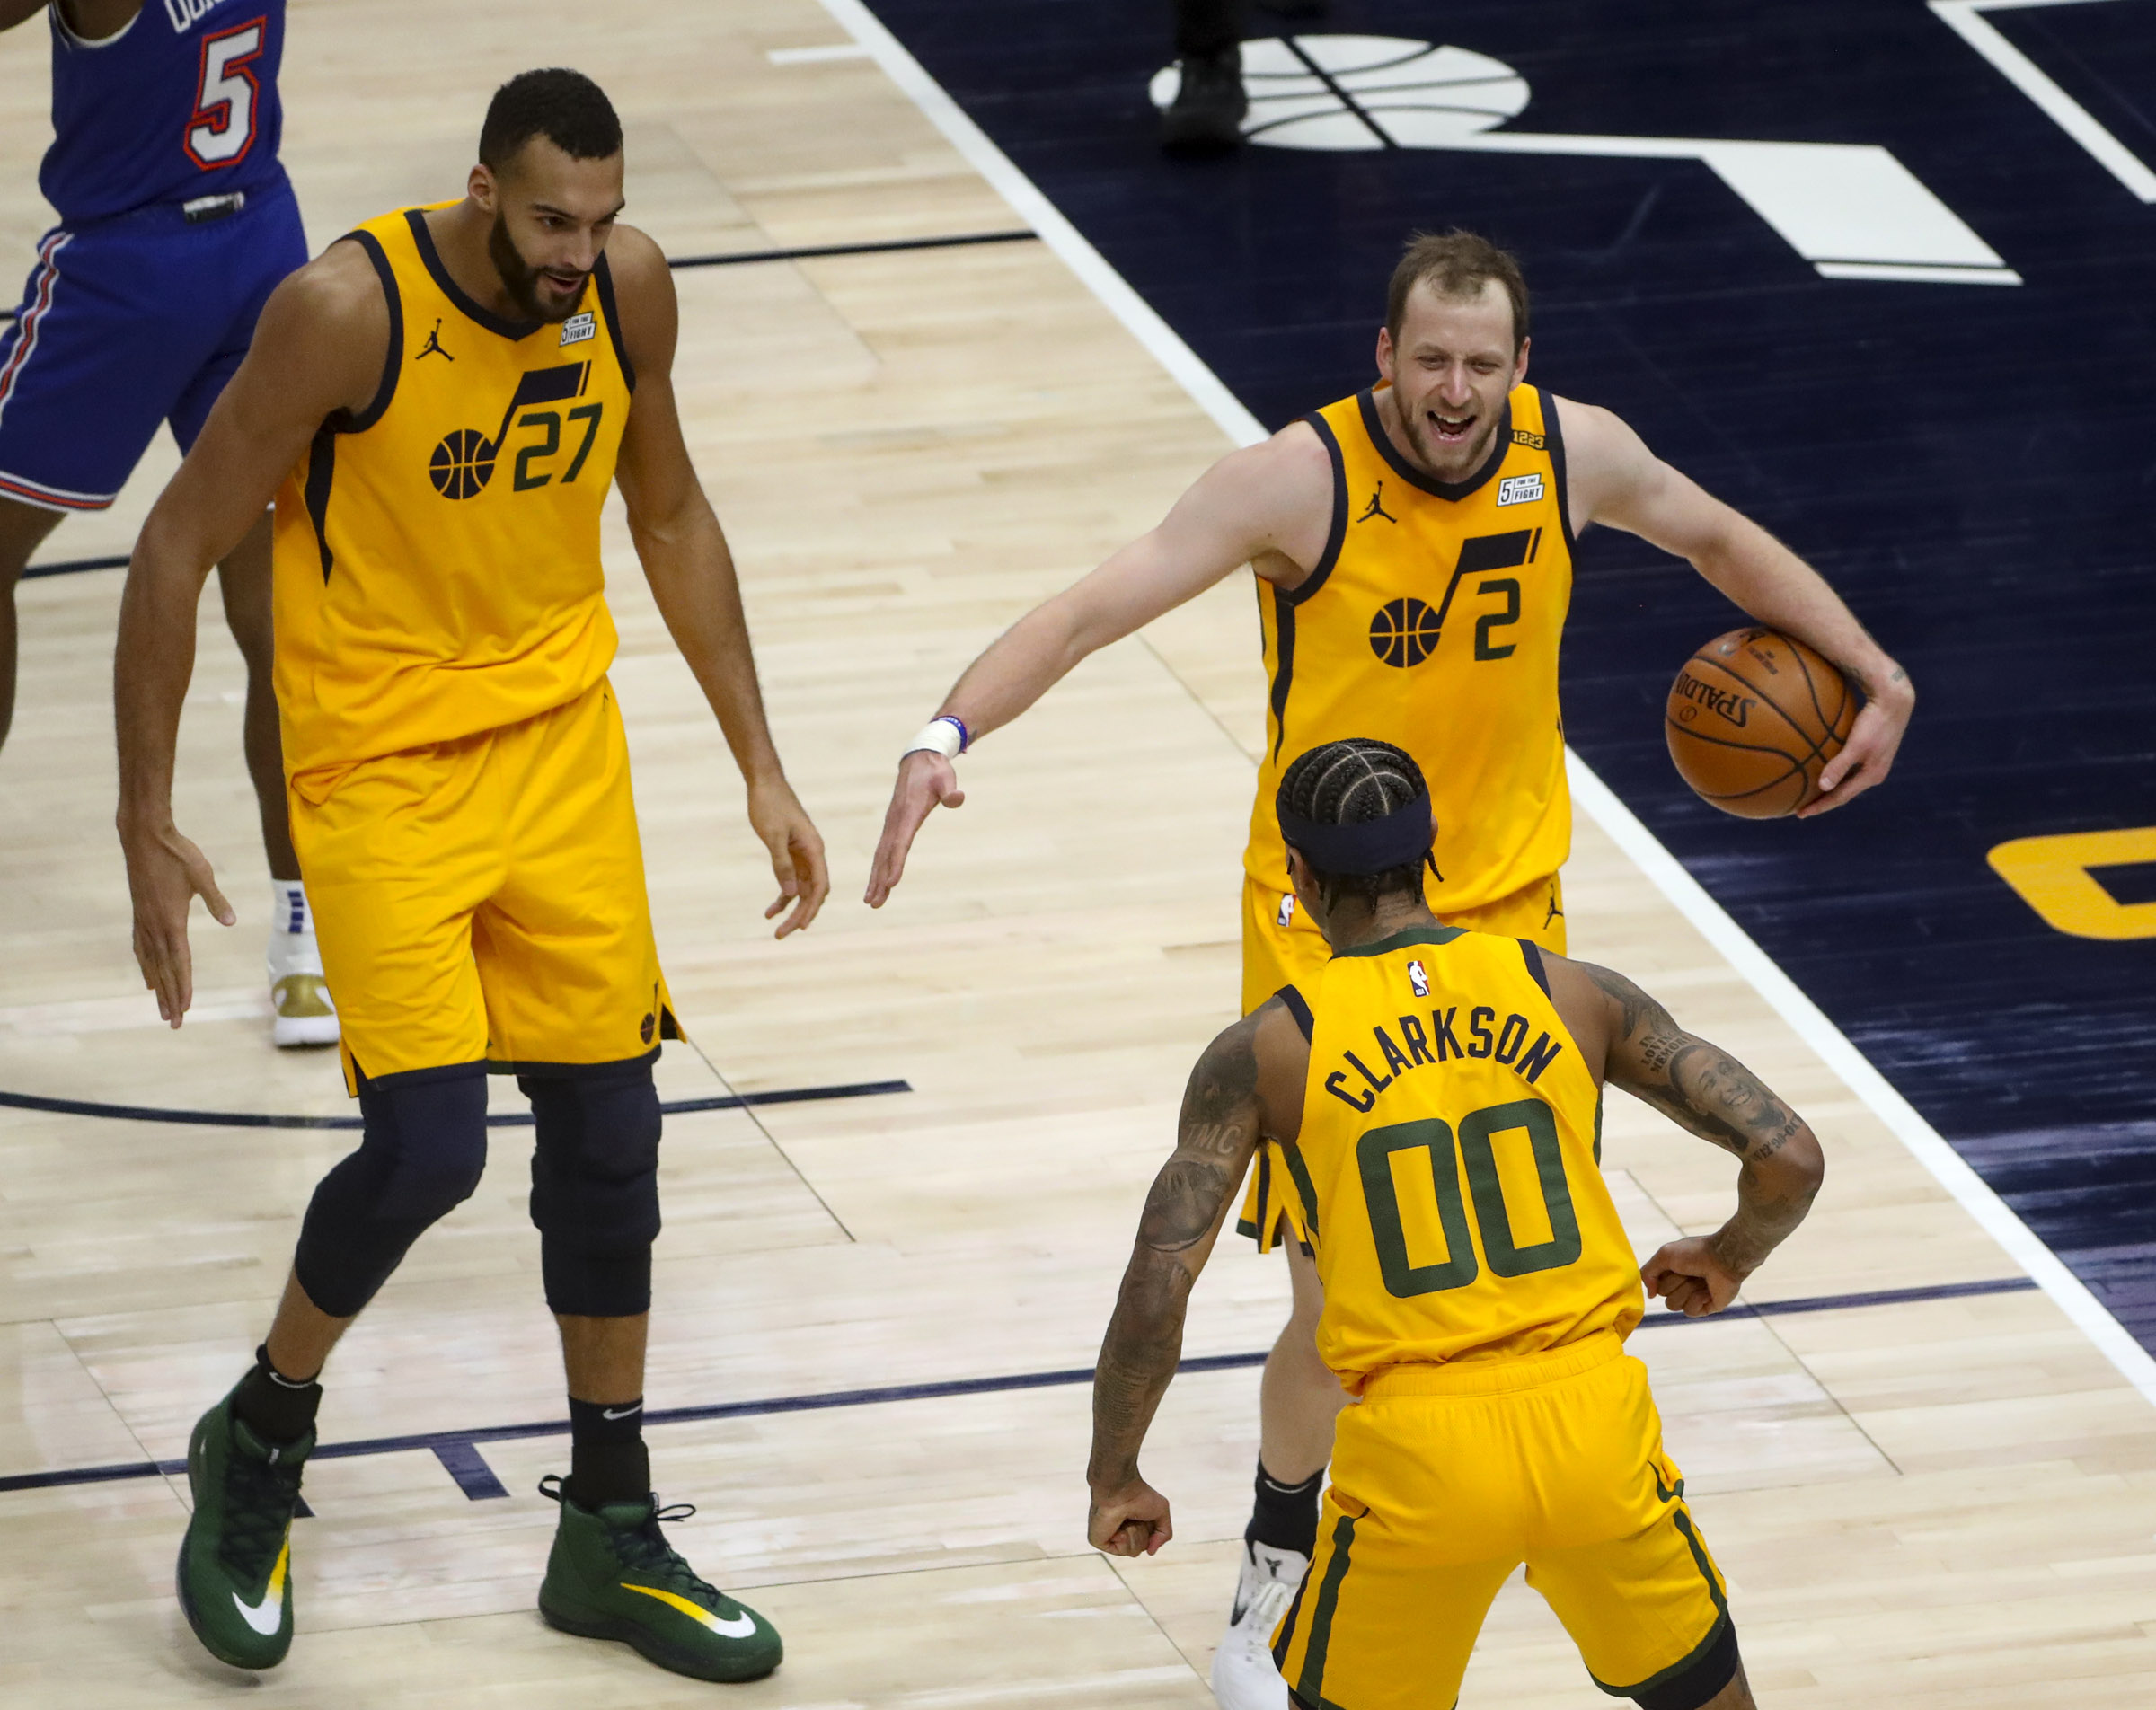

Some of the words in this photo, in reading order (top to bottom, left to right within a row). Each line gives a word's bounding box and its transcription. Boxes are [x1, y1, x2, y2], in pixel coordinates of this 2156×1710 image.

[183, 15, 266, 171] 5
[513, 402, 603, 492] 27
[1514, 431, 1544, 449] 1223
[1500, 481, 1512, 503] 5
[1515, 488, 1541, 500] FIGHT
[1474, 578, 1520, 661] 2
[1324, 1006, 1562, 1114] CLARKSON
[1356, 1098, 1582, 1298] 00
